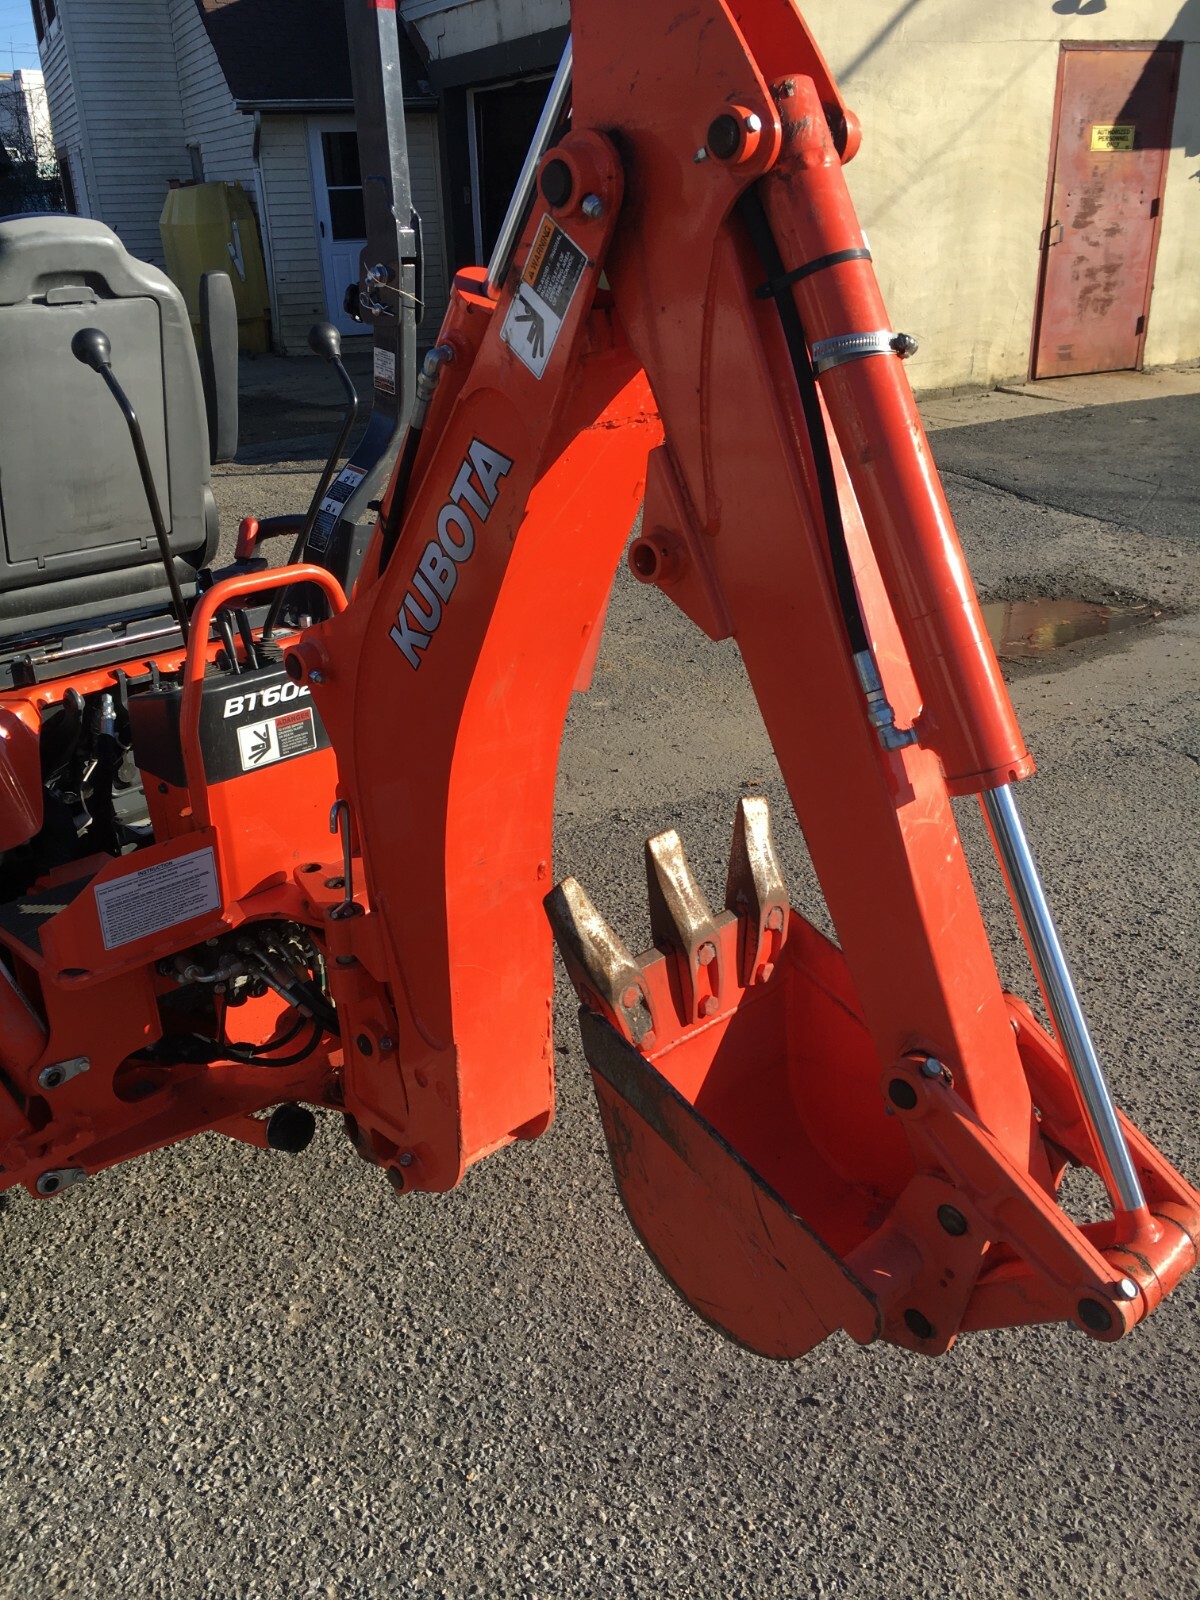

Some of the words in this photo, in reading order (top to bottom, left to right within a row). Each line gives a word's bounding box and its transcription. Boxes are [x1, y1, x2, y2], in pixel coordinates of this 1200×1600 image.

[531, 225, 551, 269] WARNING
[389, 436, 514, 671] KUBOTA
[282, 711, 310, 724] DANGER
[137, 861, 173, 876] INSTRUCTION
